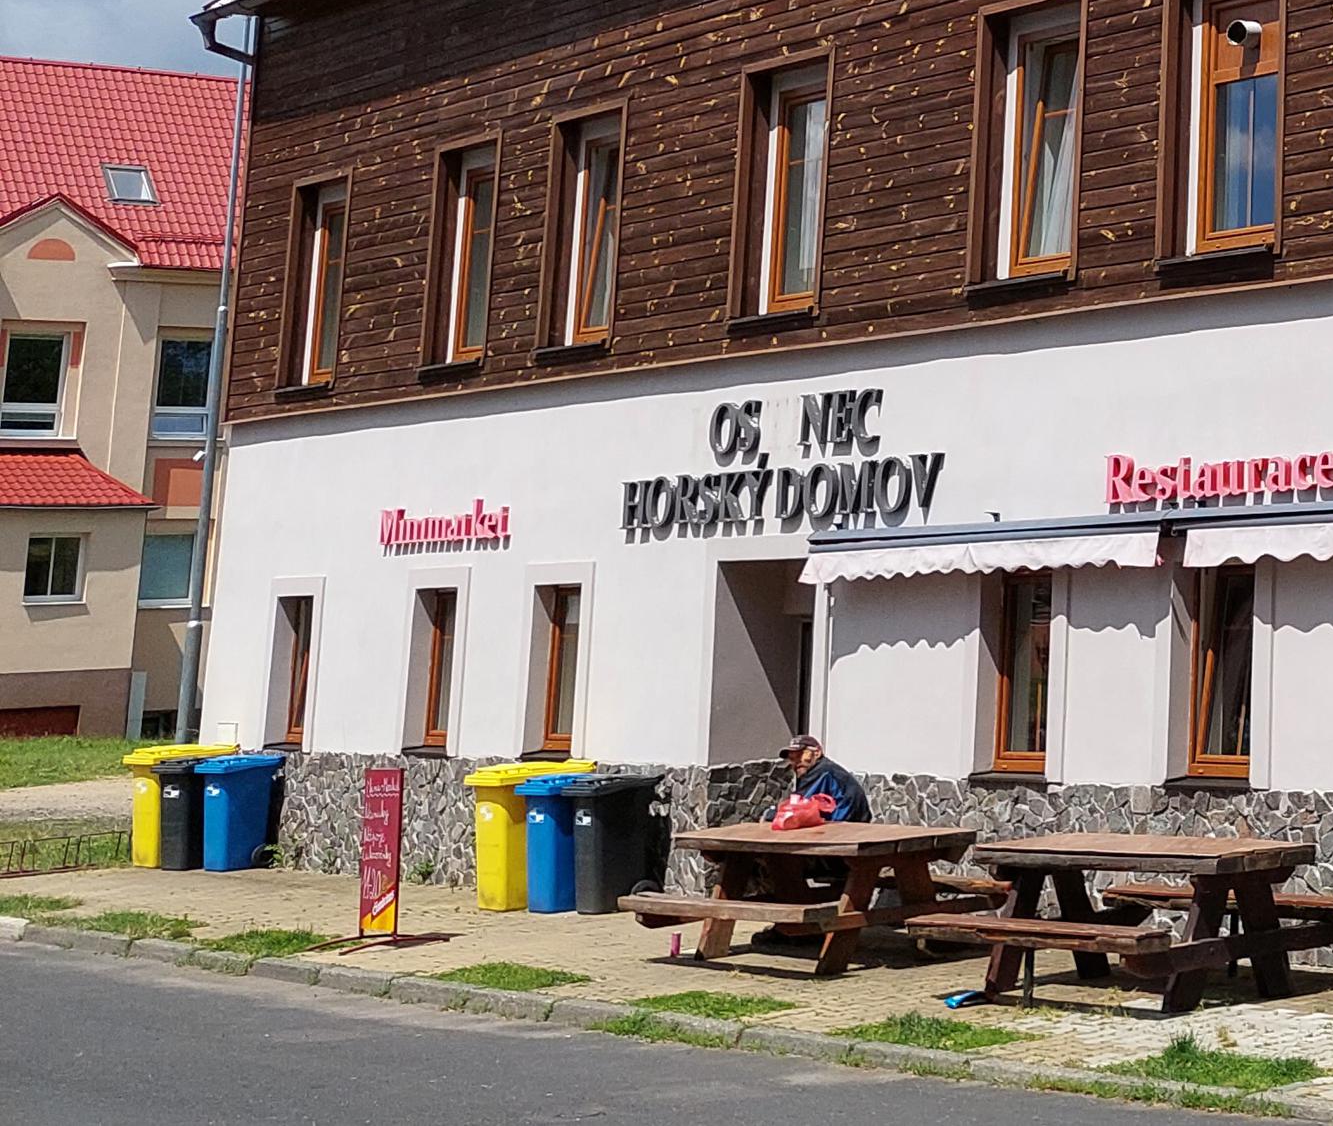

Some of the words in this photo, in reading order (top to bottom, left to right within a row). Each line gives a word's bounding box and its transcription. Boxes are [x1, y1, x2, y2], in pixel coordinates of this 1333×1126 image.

[379, 498, 510, 547] Minimarket
[620, 453, 774, 531] HORSKÝ
[775, 453, 945, 520] DOMOV
